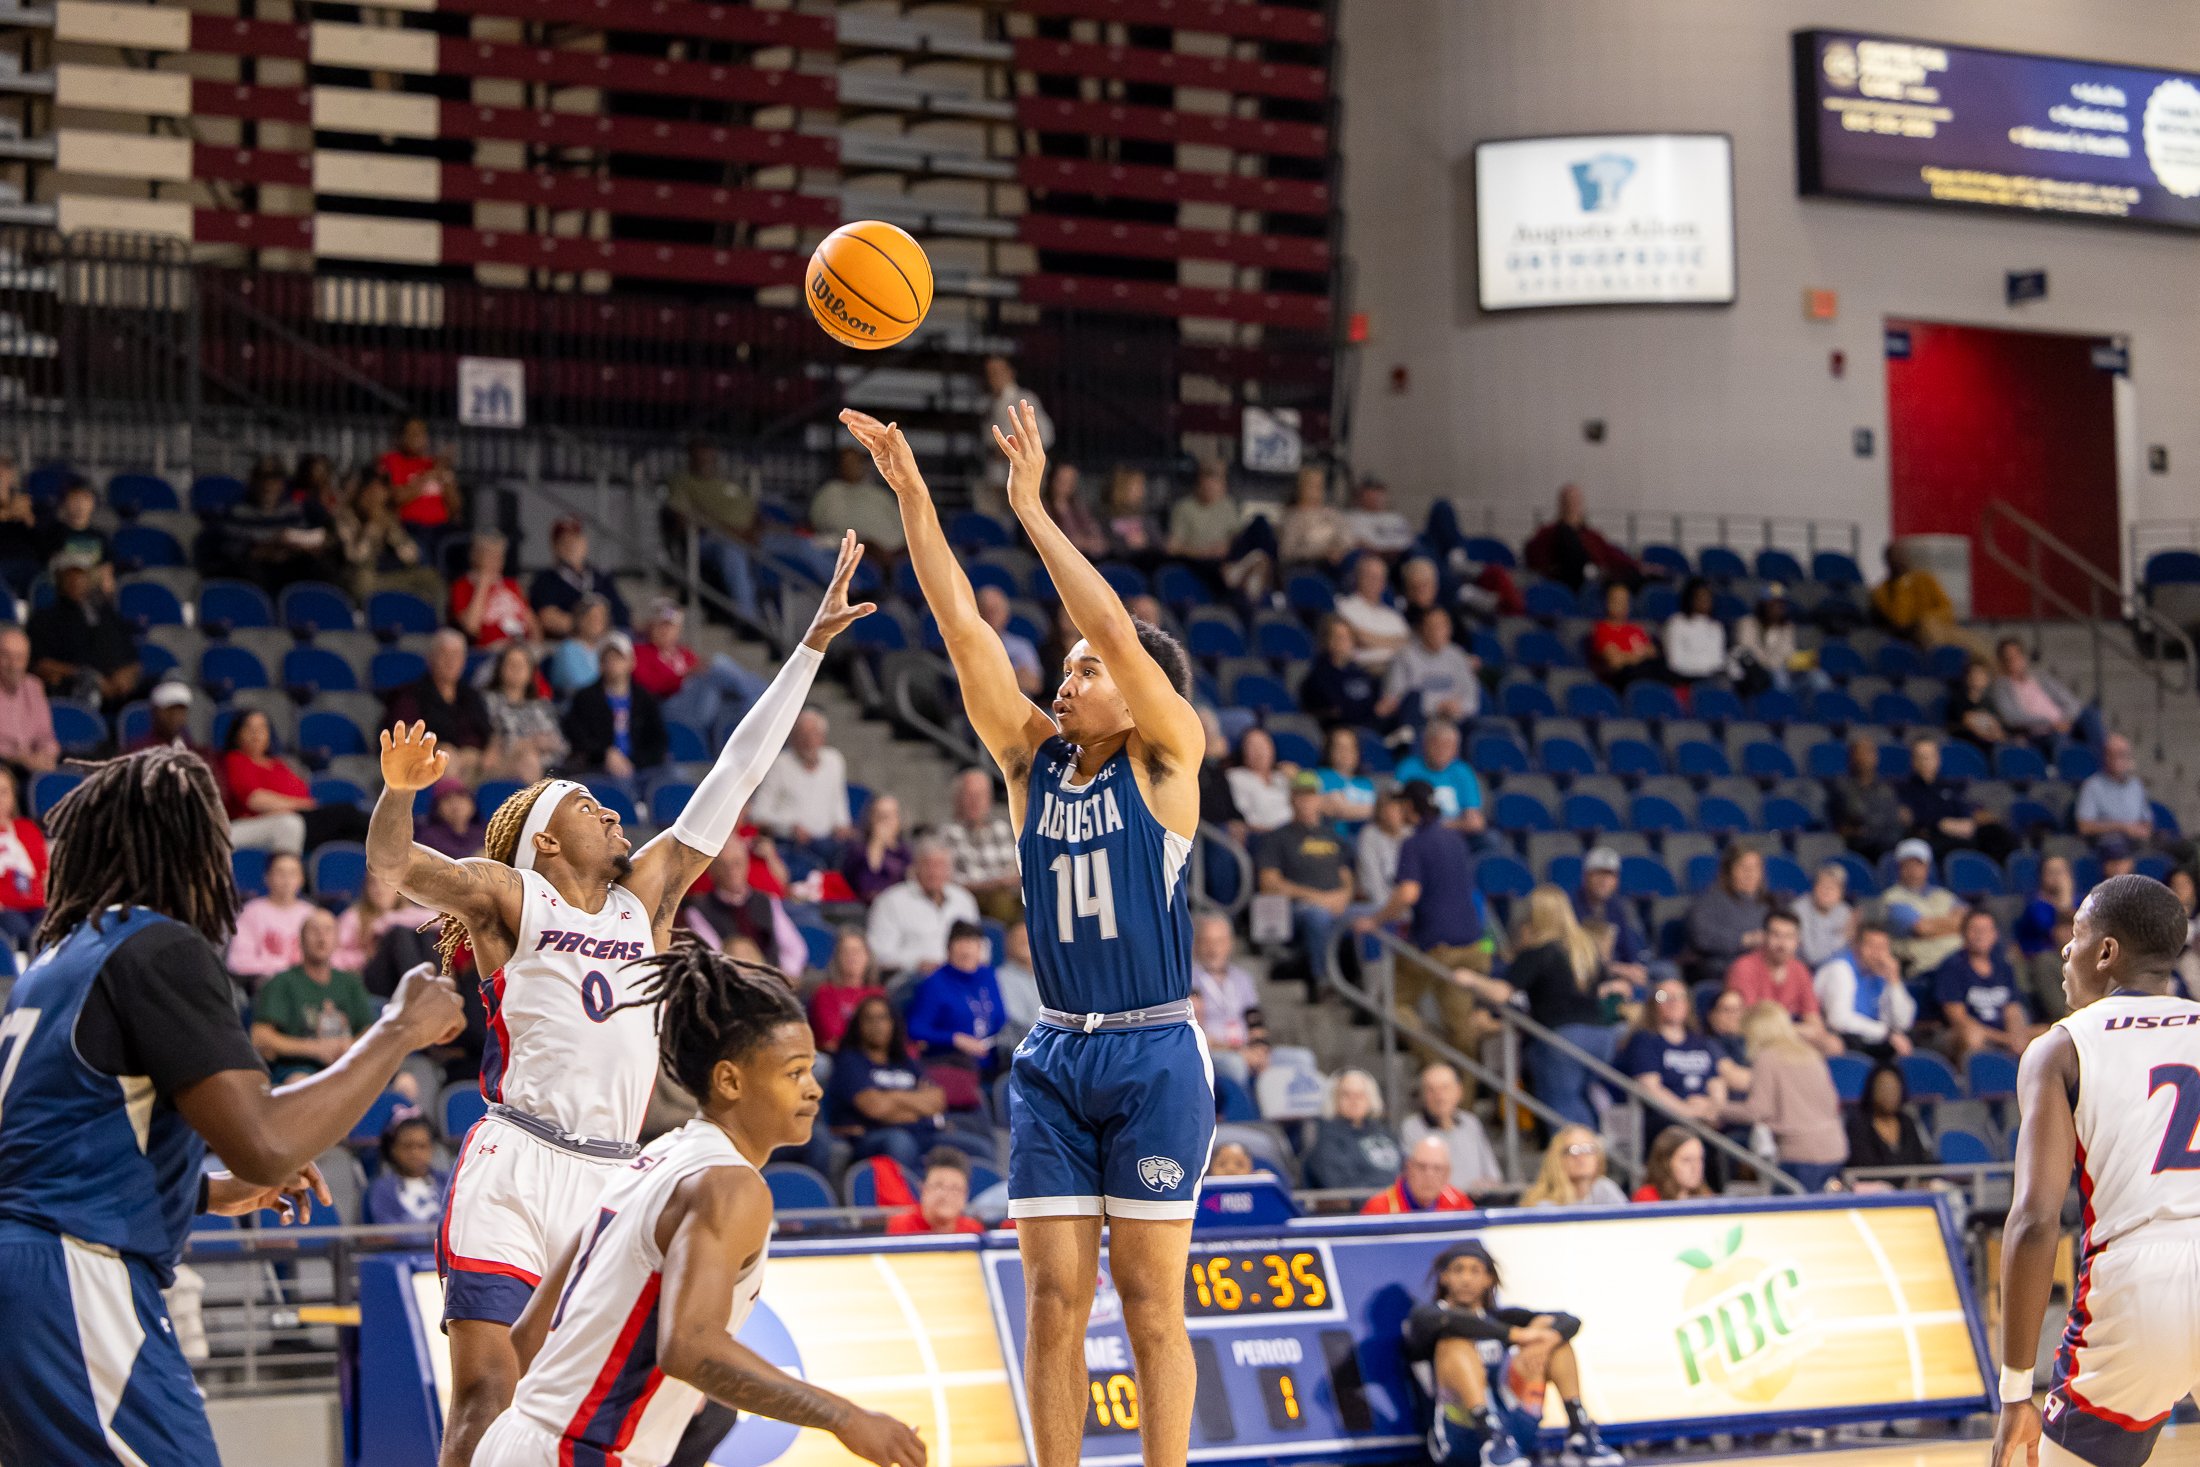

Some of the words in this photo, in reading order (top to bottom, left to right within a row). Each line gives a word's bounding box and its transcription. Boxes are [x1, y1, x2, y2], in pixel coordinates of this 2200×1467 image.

[811, 271, 877, 336] Wilson
[1049, 848, 1119, 943] 14
[534, 929, 645, 961] PACERS
[581, 970, 614, 1024] 0
[1191, 1252, 1327, 1311] 16:35
[1084, 1336, 1128, 1371] ME
[1231, 1338, 1303, 1367] PERIOD
[1674, 1267, 1799, 1387] PBC
[1090, 1374, 1139, 1430] 10
[1279, 1375, 1300, 1420] 1
